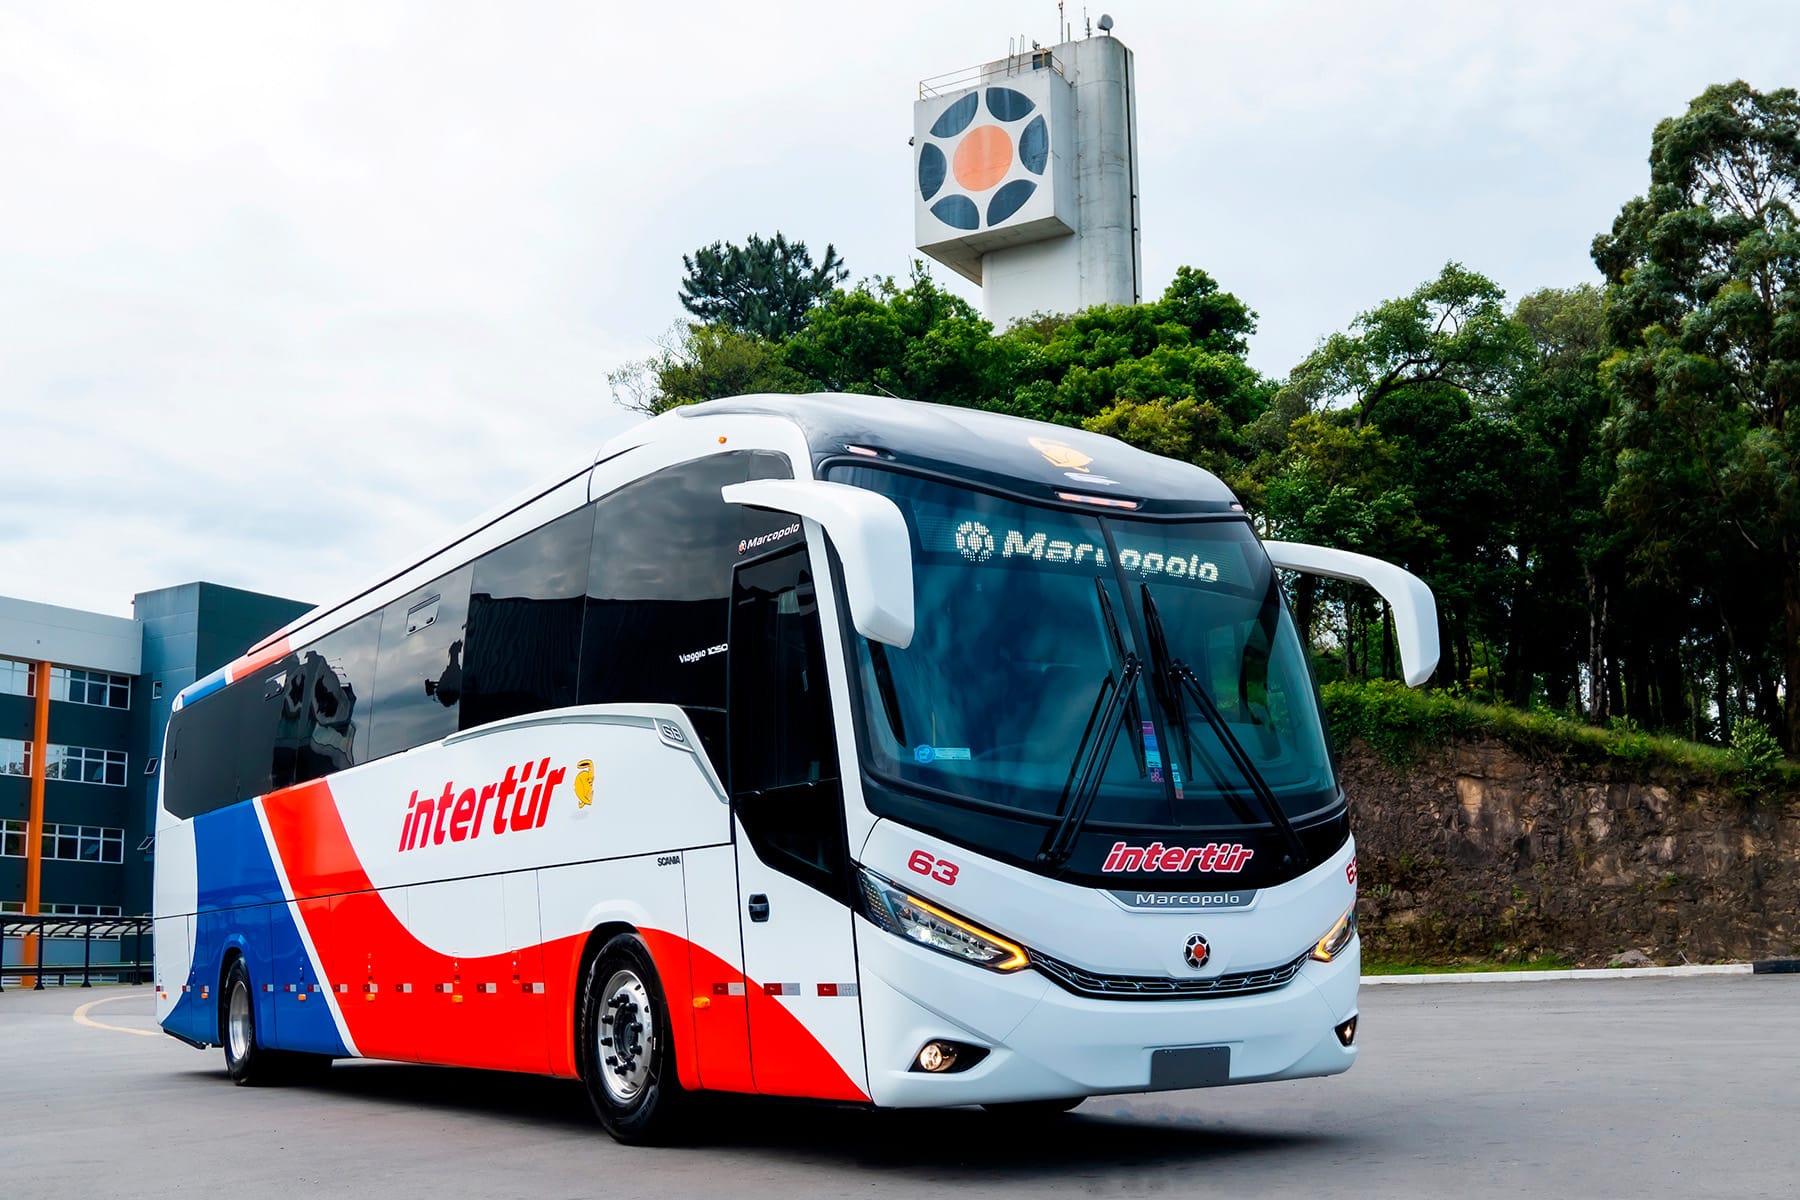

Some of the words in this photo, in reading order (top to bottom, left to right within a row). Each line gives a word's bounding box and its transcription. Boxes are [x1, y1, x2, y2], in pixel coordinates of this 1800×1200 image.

[747, 523, 800, 550] Marcopolo
[679, 649, 706, 664] Viaggio
[707, 643, 729, 655] 1050
[398, 757, 567, 852] intertür
[656, 855, 681, 867] SCANIA
[907, 849, 960, 886] 63
[1101, 841, 1254, 873] intertür
[1135, 893, 1240, 906] Marcopolo
